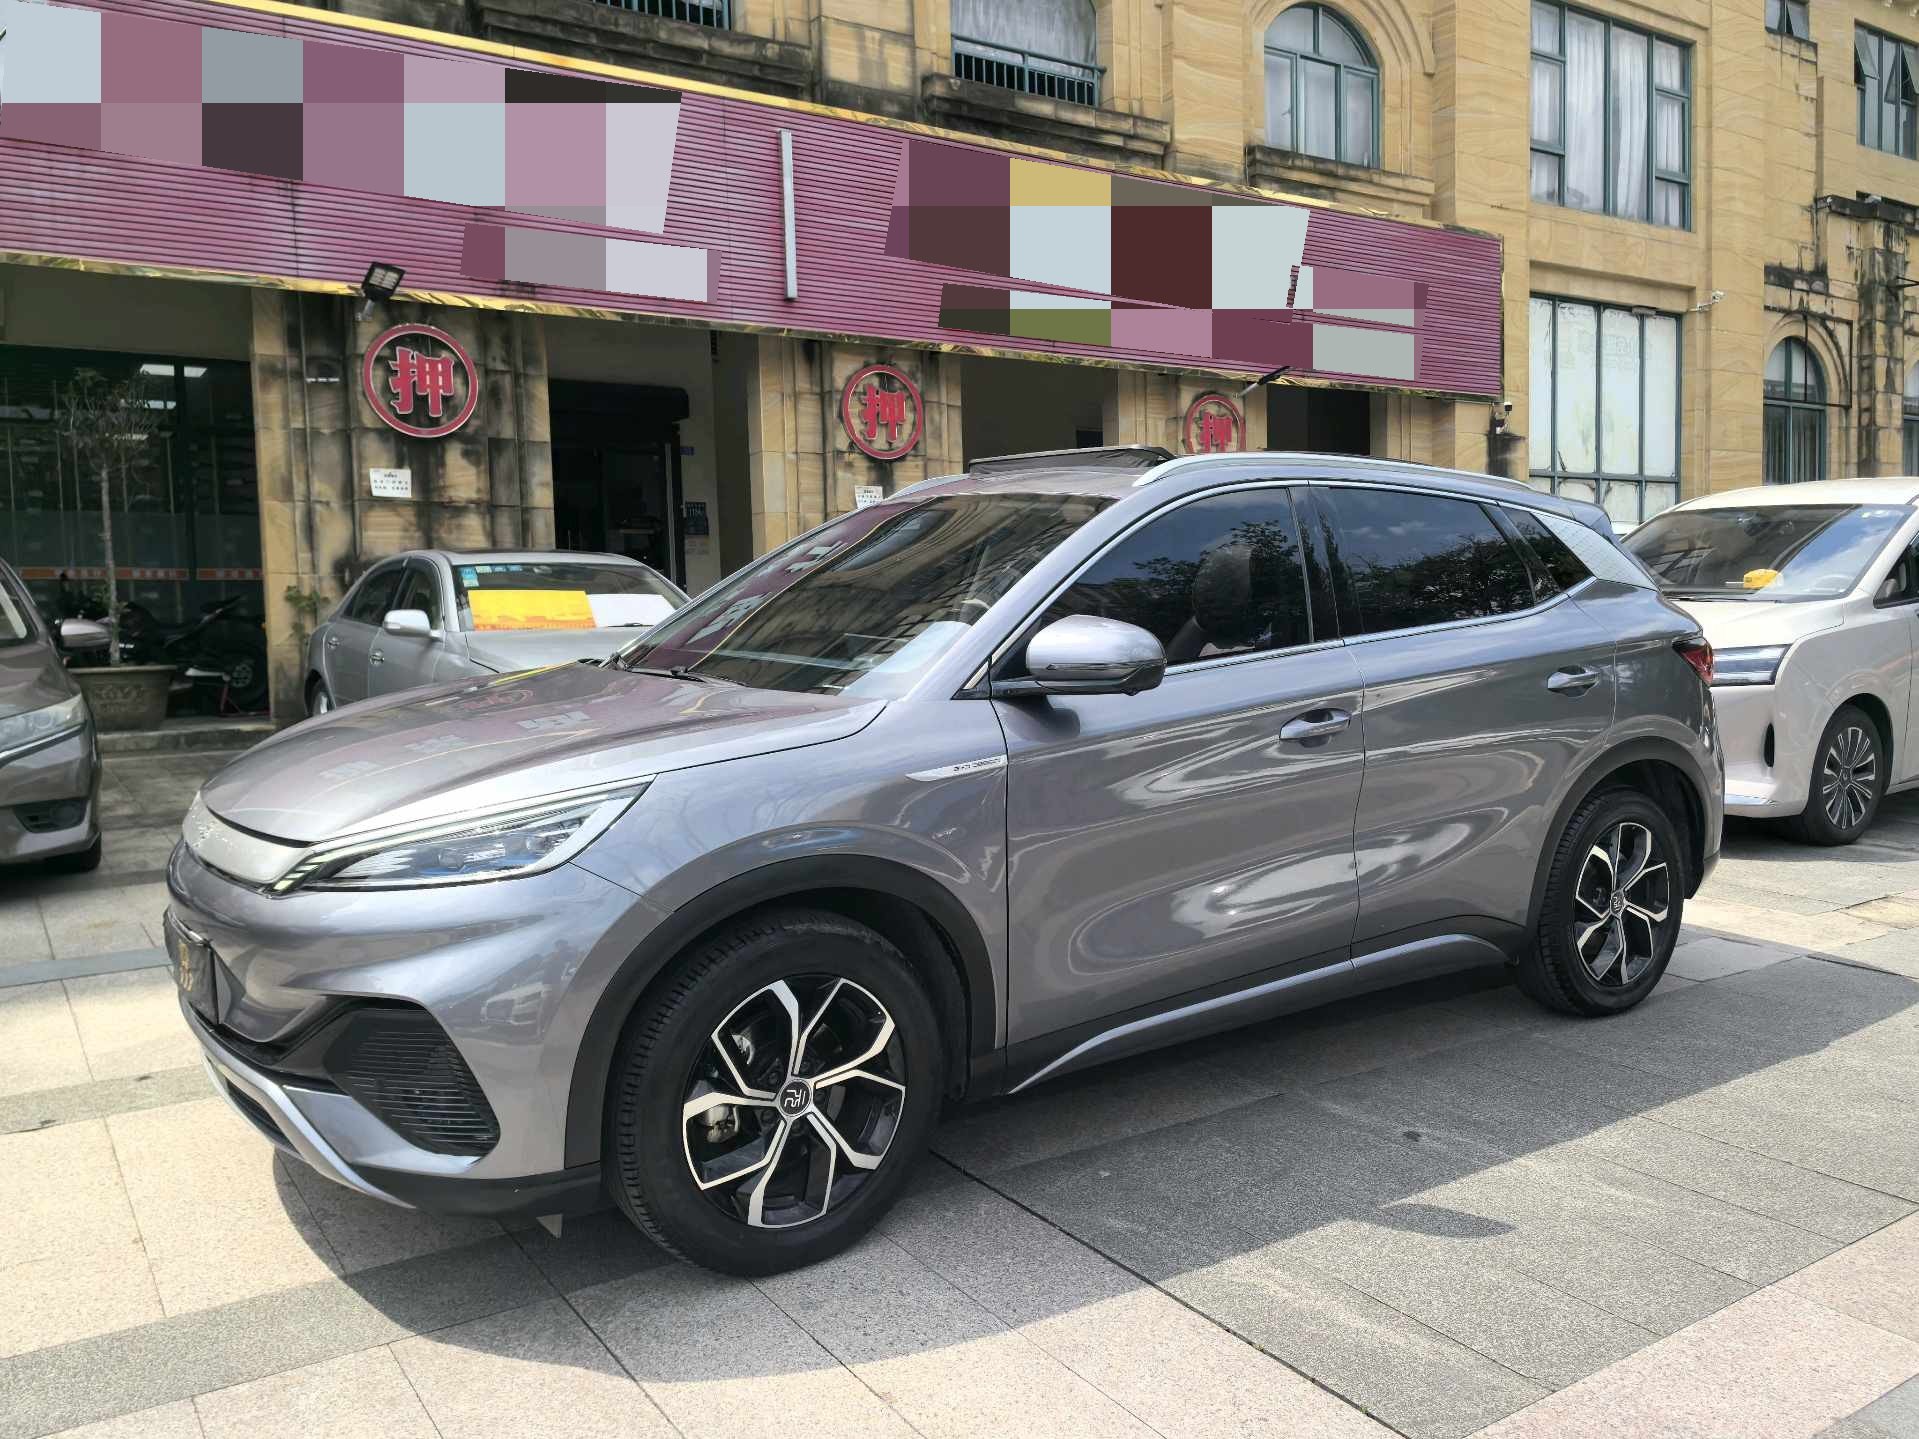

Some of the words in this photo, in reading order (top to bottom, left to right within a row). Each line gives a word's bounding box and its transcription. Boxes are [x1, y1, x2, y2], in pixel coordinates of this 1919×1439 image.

[388, 346, 455, 417] 押
[861, 383, 906, 443] 押
[1194, 409, 1233, 453] 押
